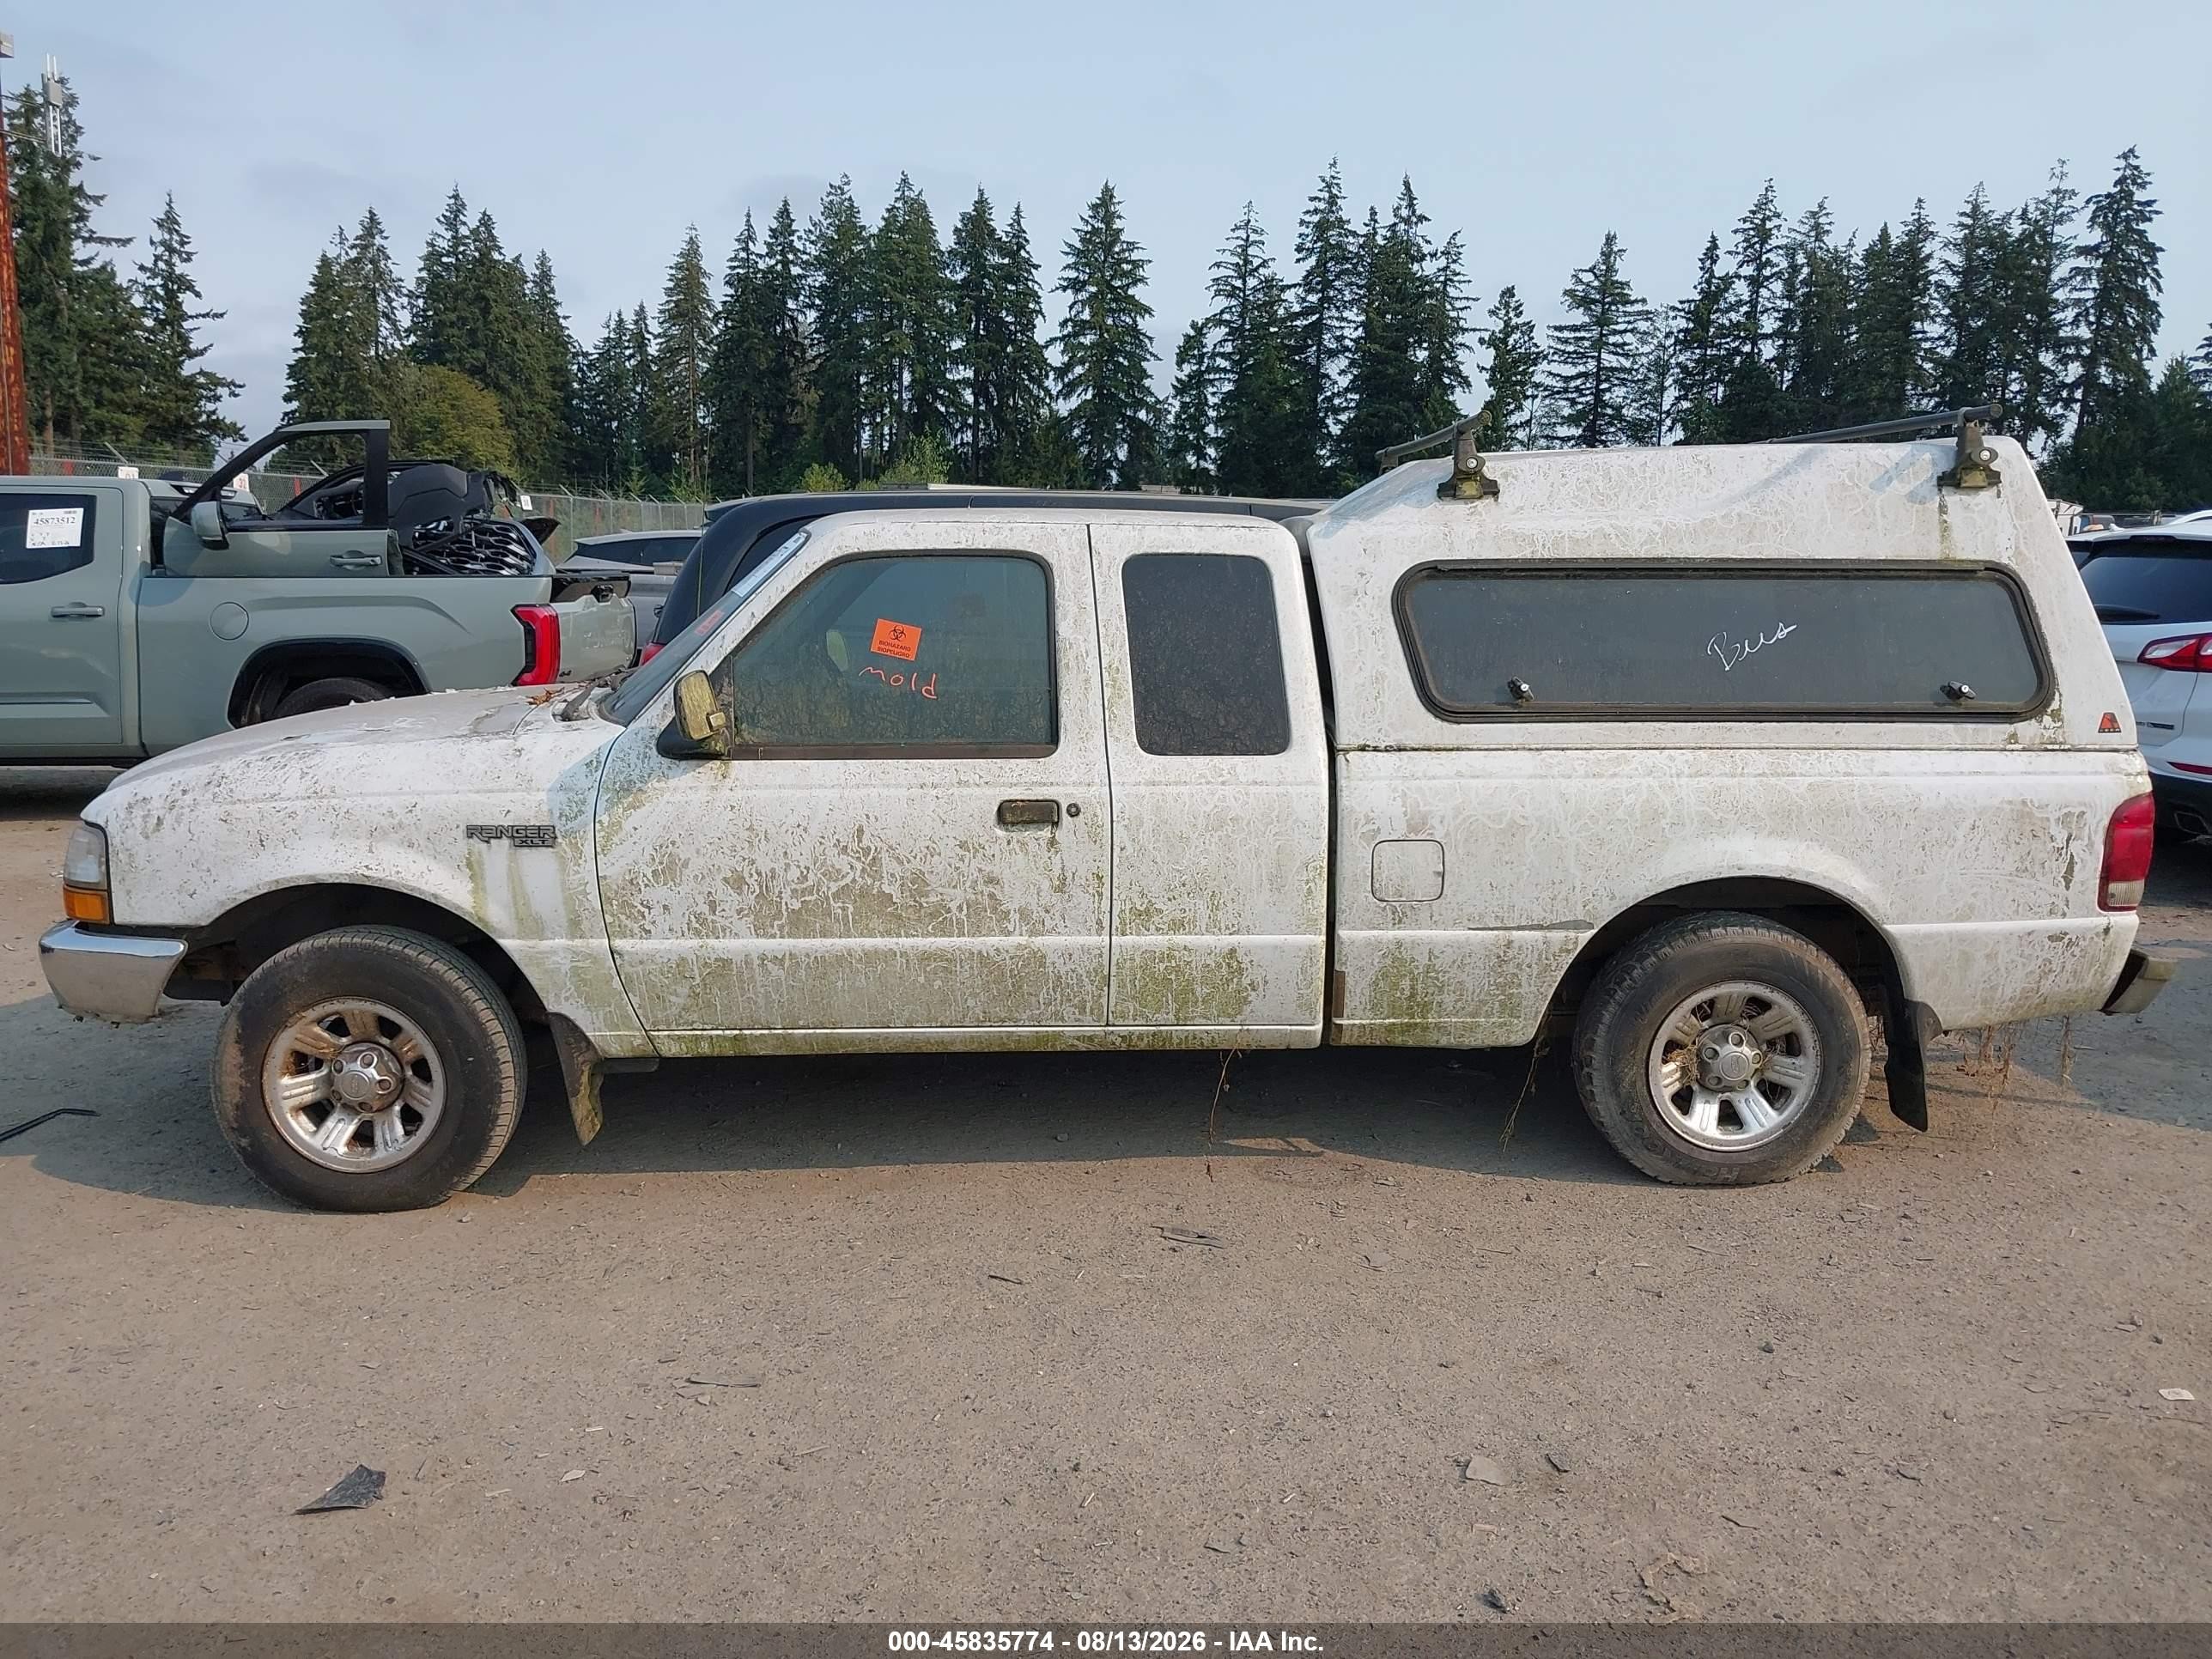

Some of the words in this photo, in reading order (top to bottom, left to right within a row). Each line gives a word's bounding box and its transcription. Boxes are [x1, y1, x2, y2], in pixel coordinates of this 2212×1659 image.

[33, 517, 76, 526] 45873512
[878, 640, 911, 652] BIOHAZARD
[878, 646, 910, 658] BIOPELIGRO
[466, 824, 557, 843] RANGER
